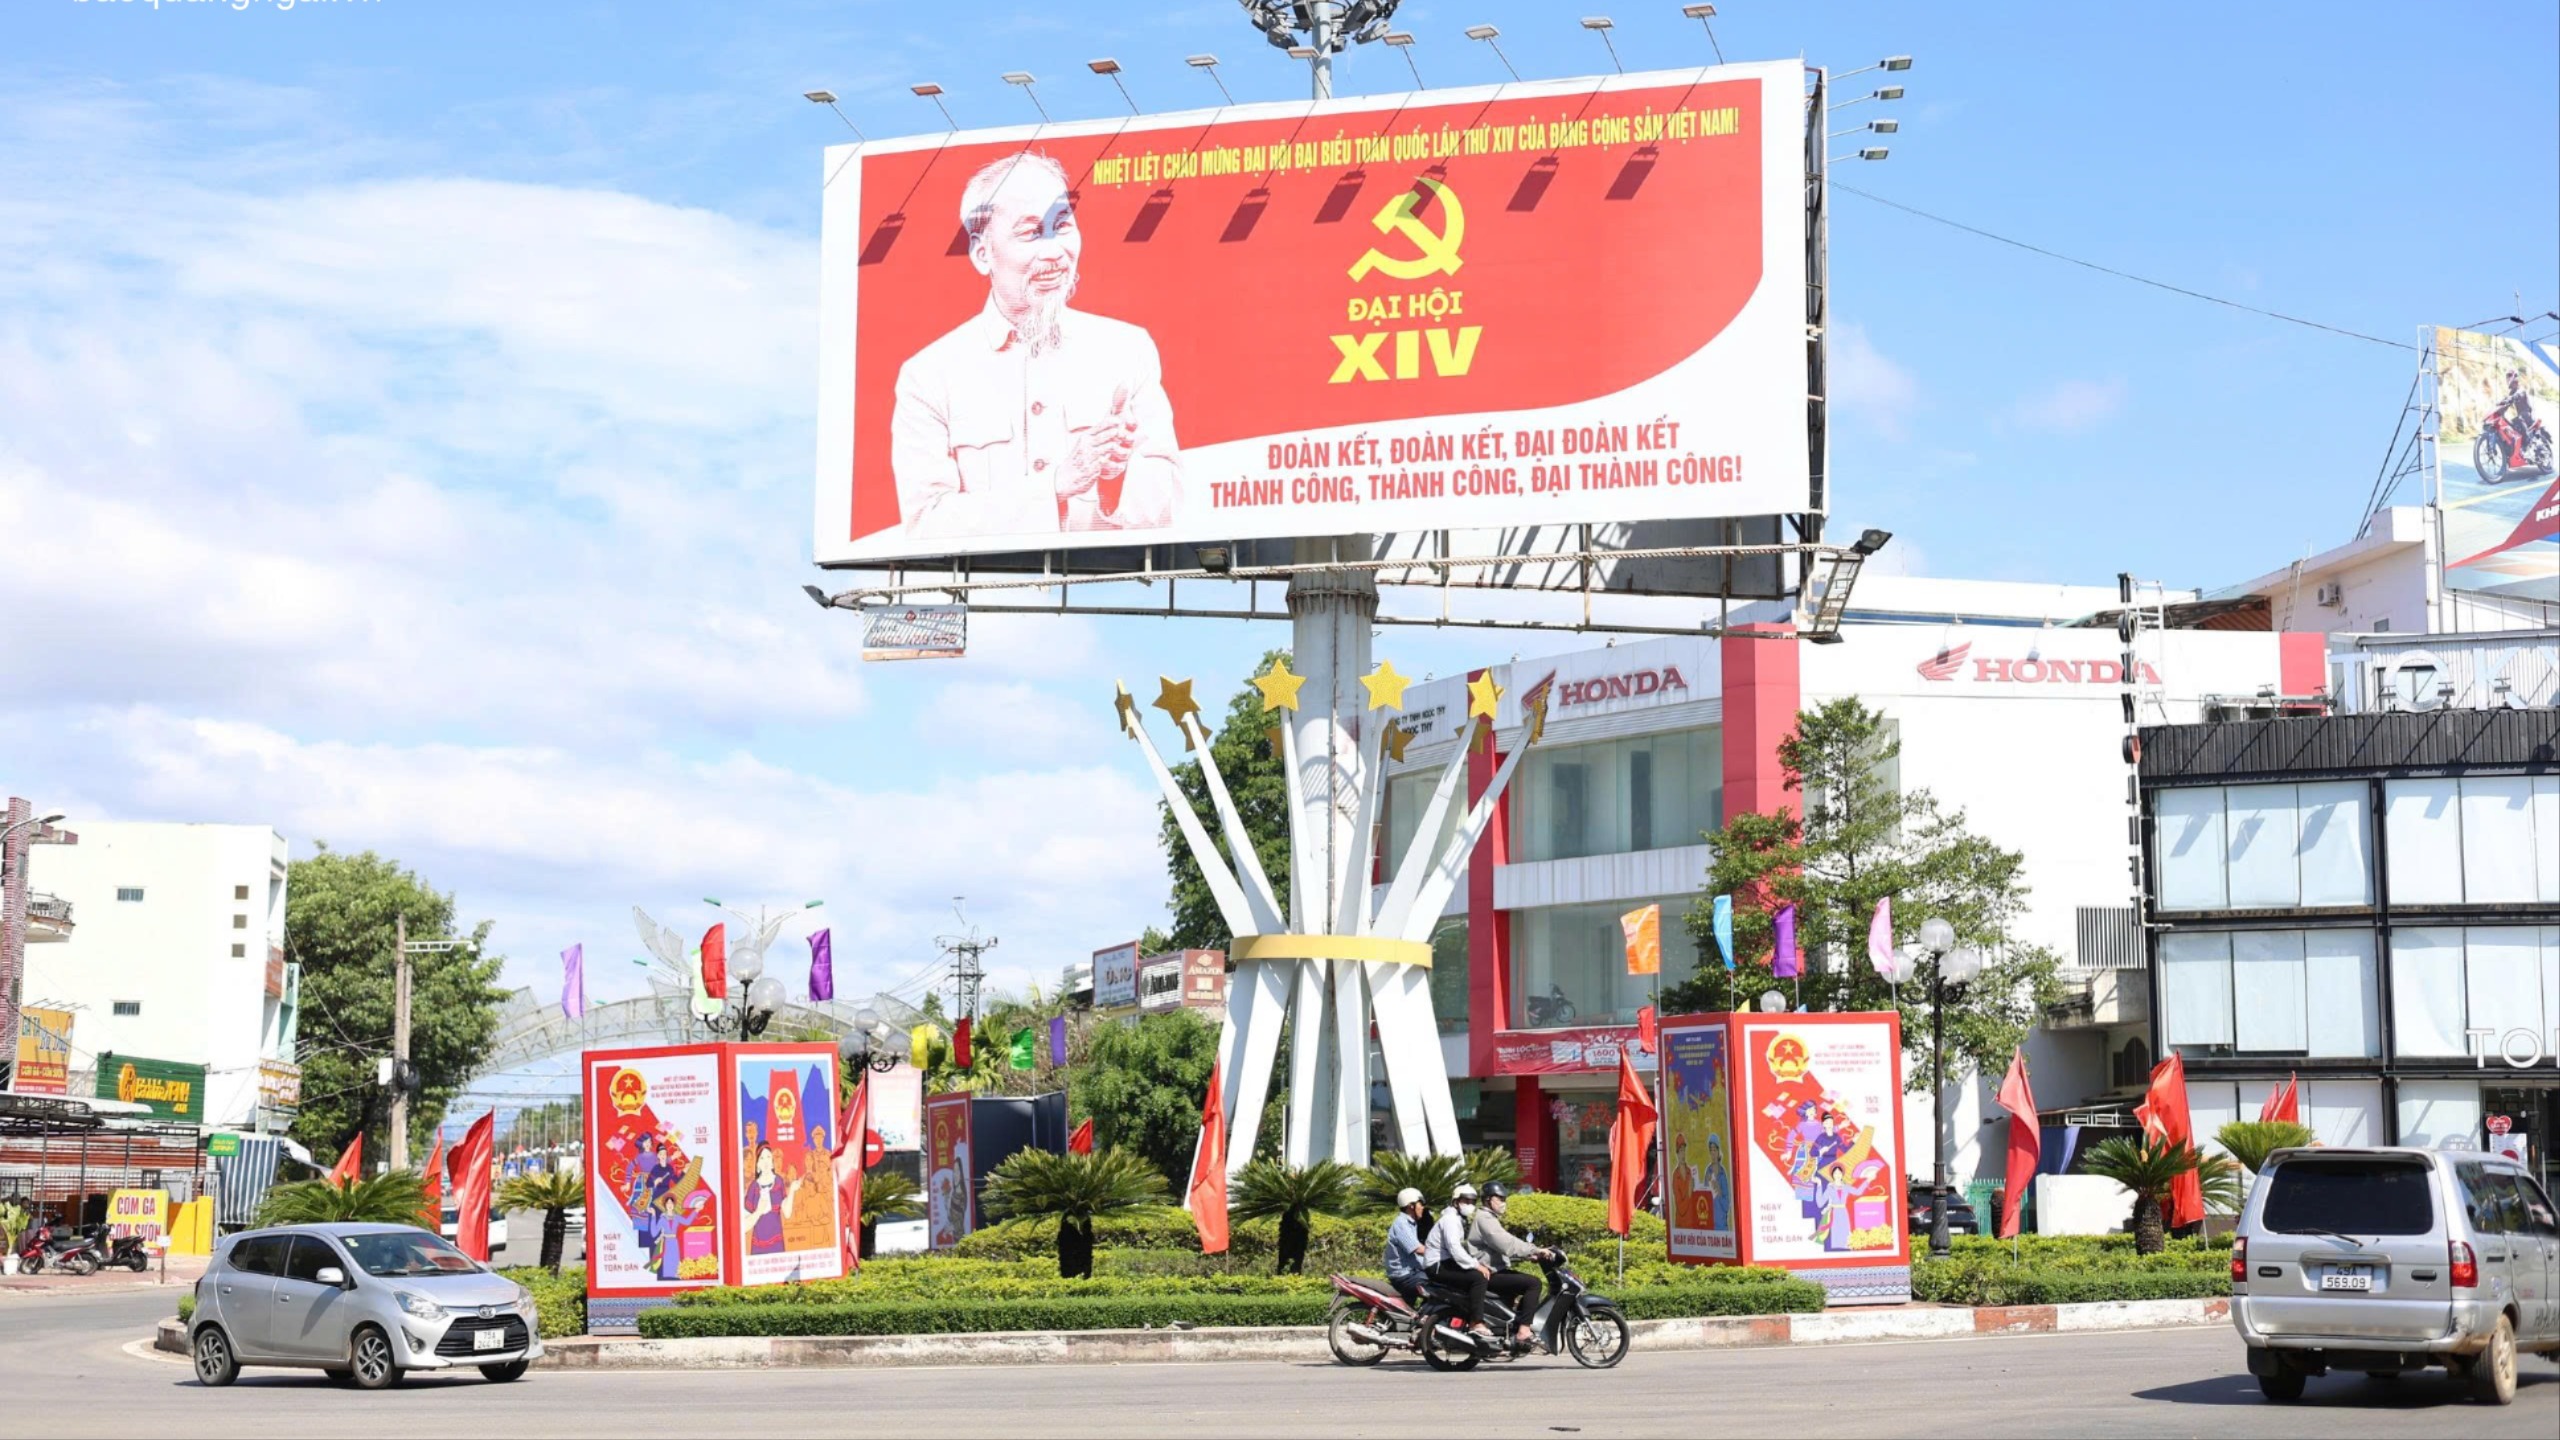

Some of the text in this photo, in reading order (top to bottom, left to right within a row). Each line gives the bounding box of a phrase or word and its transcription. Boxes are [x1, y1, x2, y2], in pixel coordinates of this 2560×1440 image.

[1093, 106, 1739, 189] NHIỆT LIỆT CHÀO MỪNG ĐẠI HỘI ĐẠI BIỂU TOÀN QUỐC LẦN THỨ XIV CỦA ĐẢNG CỘNG SẢN VIỆT NAM!
[1348, 287, 1463, 327] ĐẠI HỘI
[1327, 325, 1483, 384] XIV
[1267, 413, 1680, 470] ĐOÀN KẾT, ĐOÀN KẾT, ĐẠI ĐOÀN KẾT
[1210, 451, 1742, 508] THÀNH CÔNG, THÀNH CÔNG, ĐẠI THÀNH CÔNG!
[1558, 666, 1689, 707] HONDA
[1973, 658, 2163, 685] HONDA
[2327, 1277, 2366, 1288] 569.09
